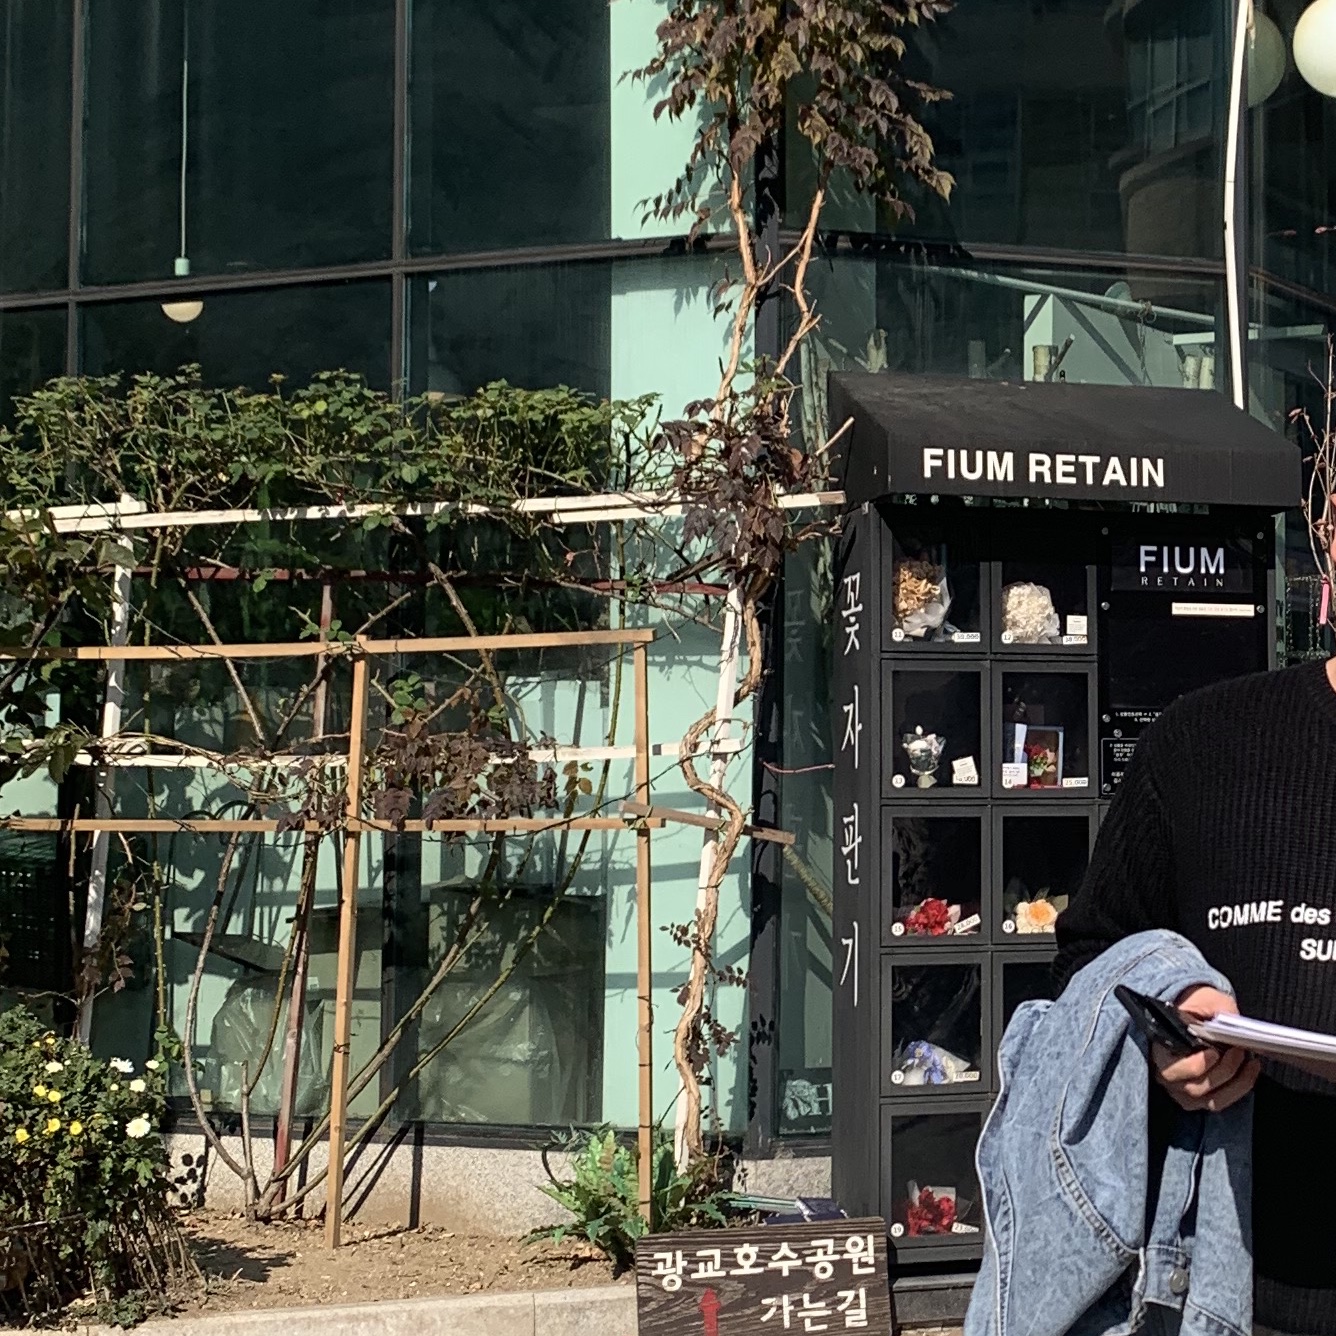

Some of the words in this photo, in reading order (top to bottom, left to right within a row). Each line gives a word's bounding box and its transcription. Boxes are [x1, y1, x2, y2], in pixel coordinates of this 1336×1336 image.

[923, 448, 1014, 482] FIUM
[1028, 453, 1165, 487] RETAIN
[1140, 545, 1224, 574] FIUM
[1141, 576, 1224, 587] RETAIN
[840, 572, 863, 1008] 꽃자판기
[1208, 900, 1284, 930] COMME
[1291, 903, 1330, 925] des
[651, 1235, 876, 1291] 광교호수공원
[760, 1288, 869, 1331] 가는길
